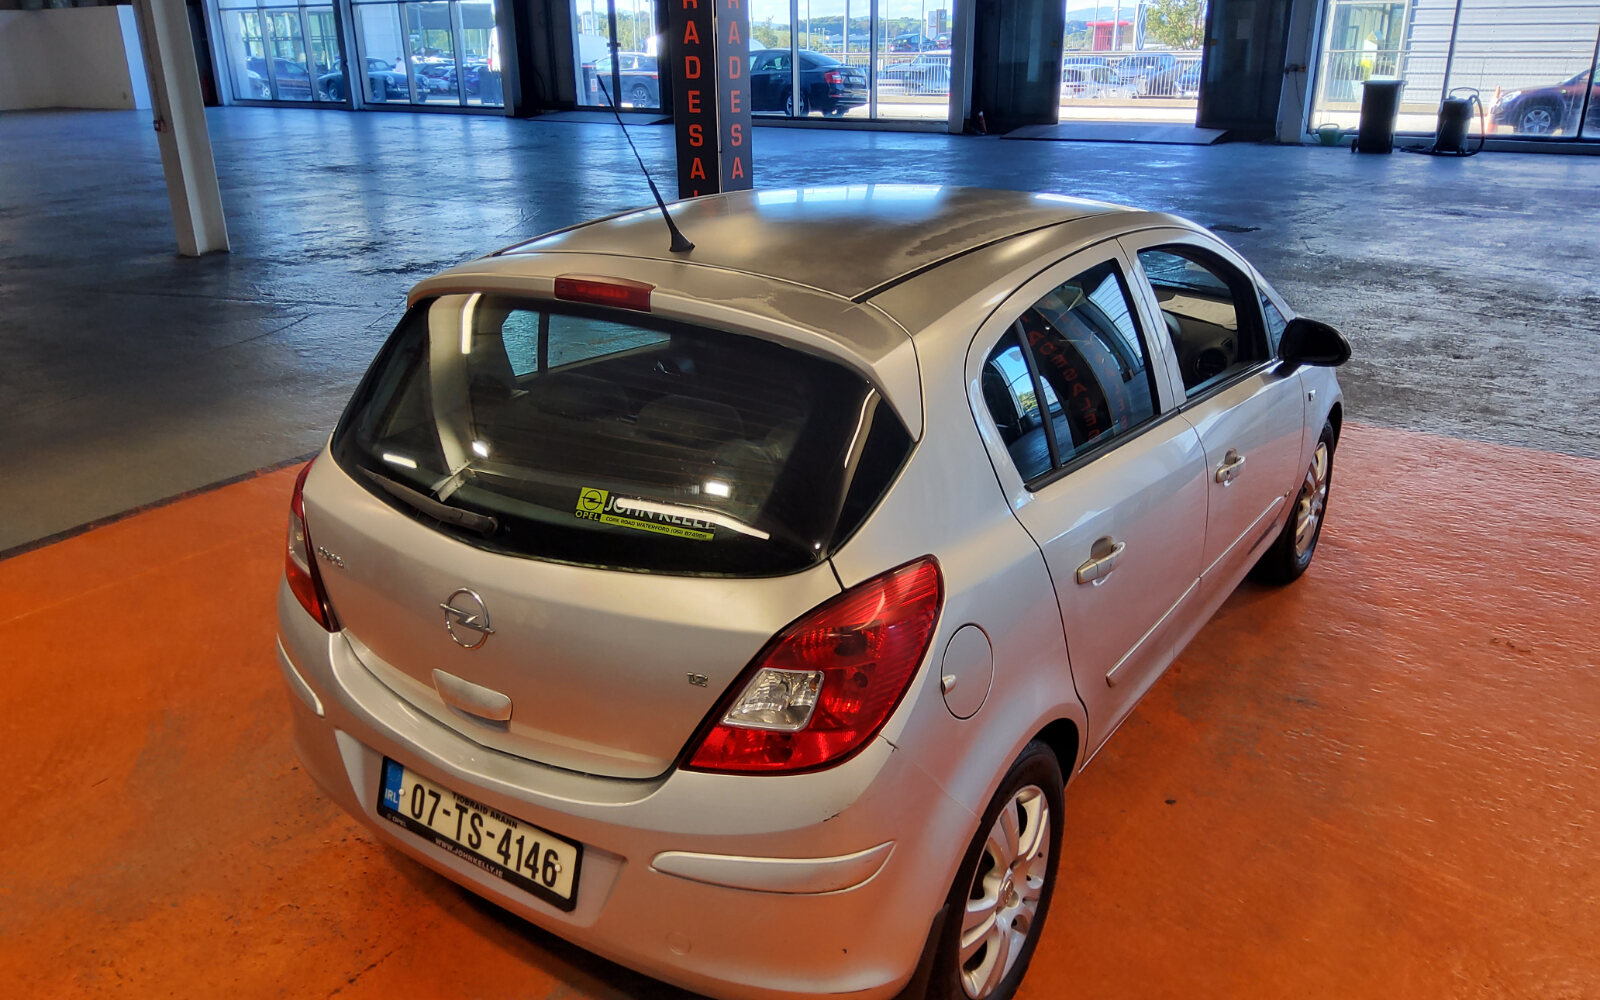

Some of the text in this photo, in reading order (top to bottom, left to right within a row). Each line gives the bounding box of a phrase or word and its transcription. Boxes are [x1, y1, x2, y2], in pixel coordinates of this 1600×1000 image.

[575, 511, 599, 521] OPEL
[636, 522, 670, 533] WATERFORD
[384, 787, 399, 804] IRL
[452, 791, 488, 815] TIOBRAID
[410, 783, 559, 888] 07-TS-4146
